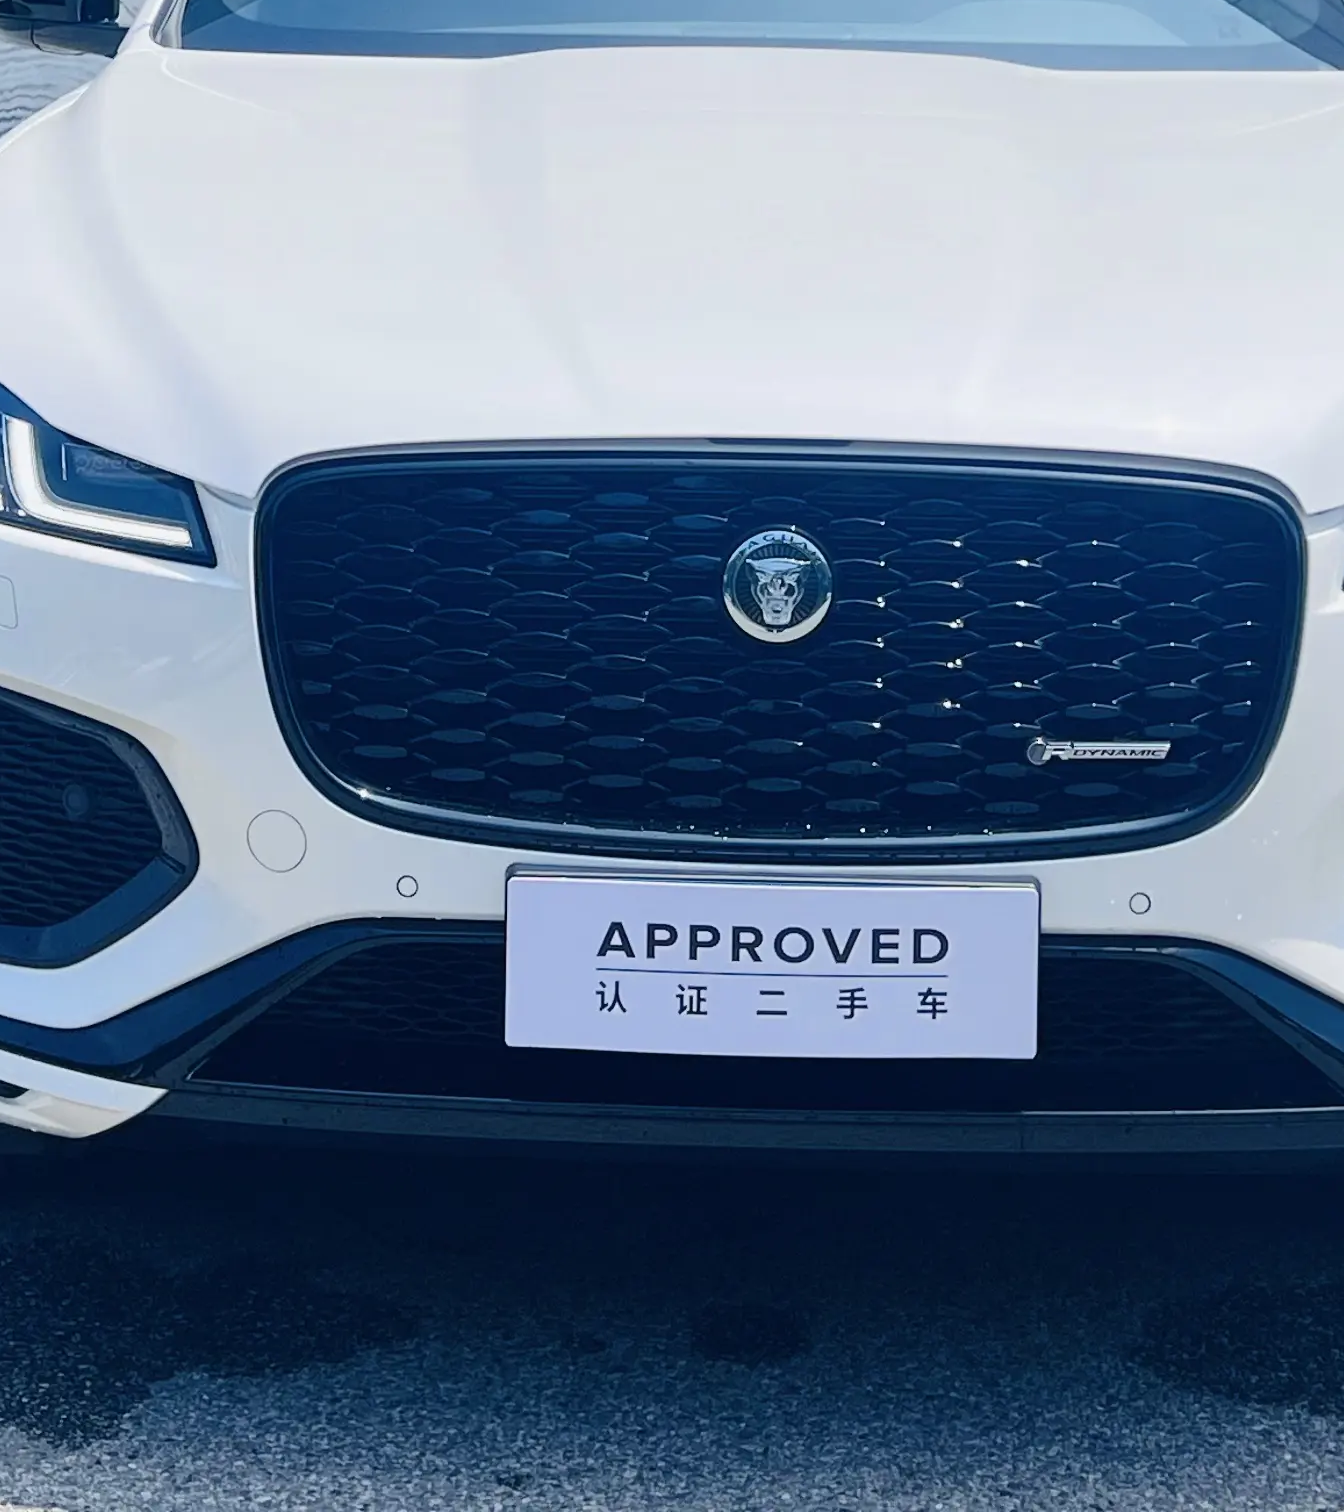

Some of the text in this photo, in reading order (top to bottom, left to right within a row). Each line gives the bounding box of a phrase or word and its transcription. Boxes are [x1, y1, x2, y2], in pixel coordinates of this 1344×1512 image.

[1073, 748, 1166, 758] DYNAMIC
[597, 921, 950, 965] APPROVED
[595, 981, 949, 1020] 认证二手车
